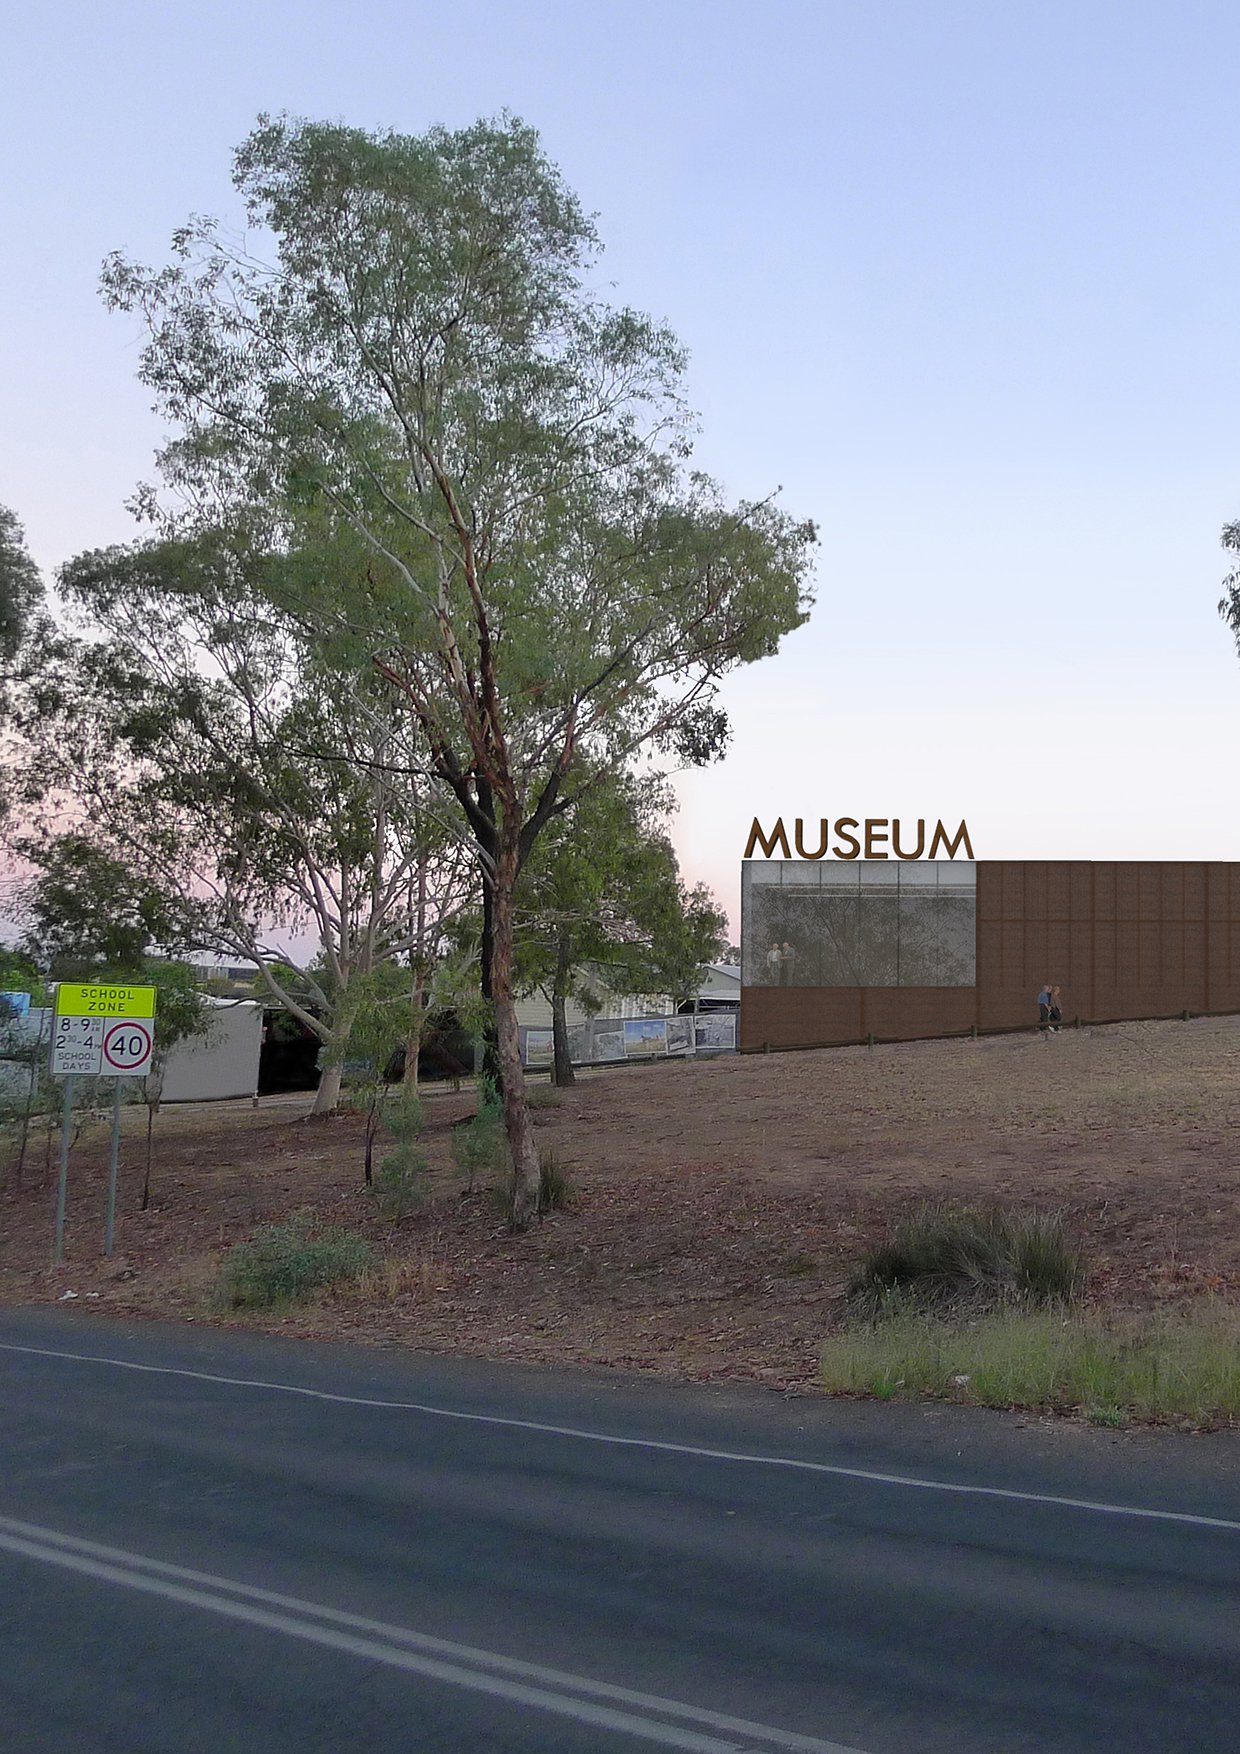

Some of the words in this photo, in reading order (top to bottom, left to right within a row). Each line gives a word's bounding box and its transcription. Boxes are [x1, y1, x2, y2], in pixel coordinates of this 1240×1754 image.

[743, 816, 975, 860] MUSEUM
[81, 989, 135, 1000] SCHOOL
[88, 1002, 126, 1012] ZONE
[111, 1036, 143, 1056] 40
[58, 1052, 96, 1061] SCHOOL
[62, 1062, 90, 1070] DAYS
